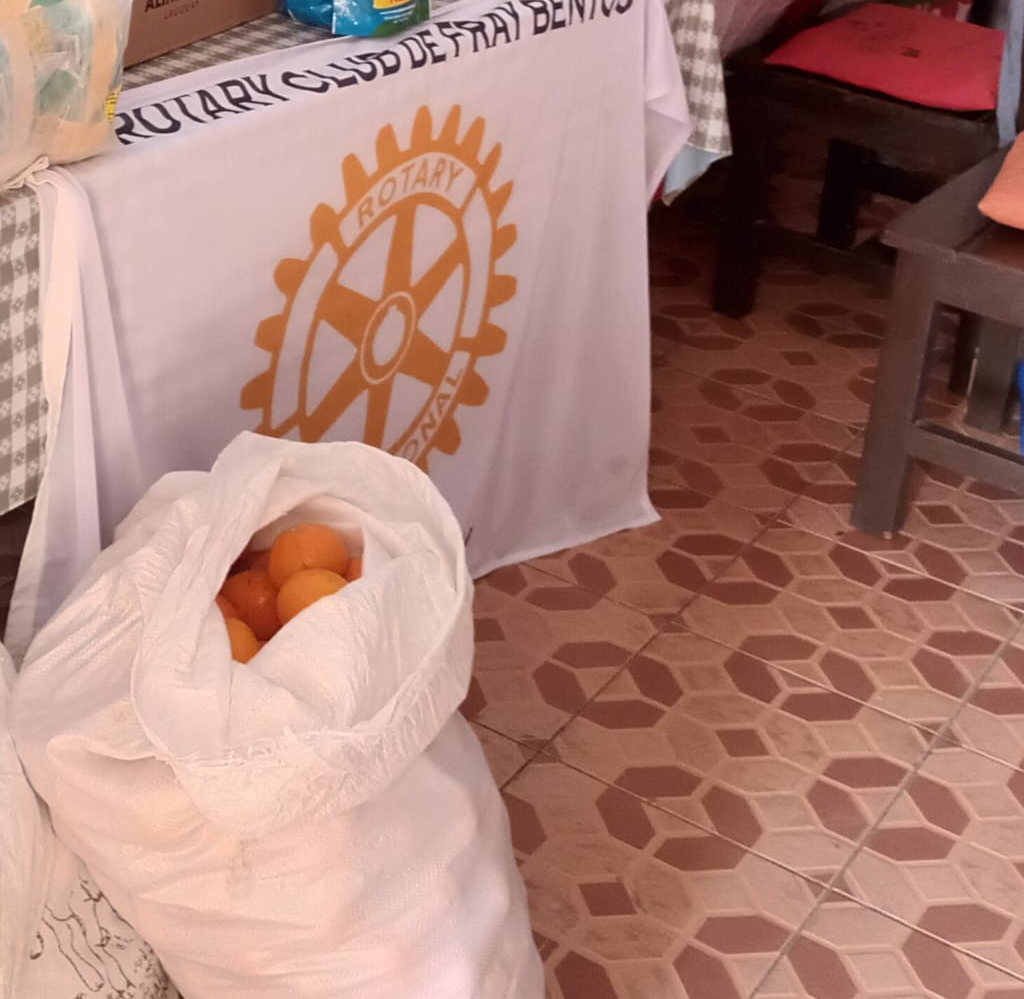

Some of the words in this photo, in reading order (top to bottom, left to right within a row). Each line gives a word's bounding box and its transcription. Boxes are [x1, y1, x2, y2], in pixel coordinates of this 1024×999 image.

[114, 73, 290, 145] ROTARY
[281, 49, 401, 94] CLUB
[397, 29, 447, 70] DE
[435, 1, 521, 58] FRAY
[357, 156, 464, 229] ROTARY
